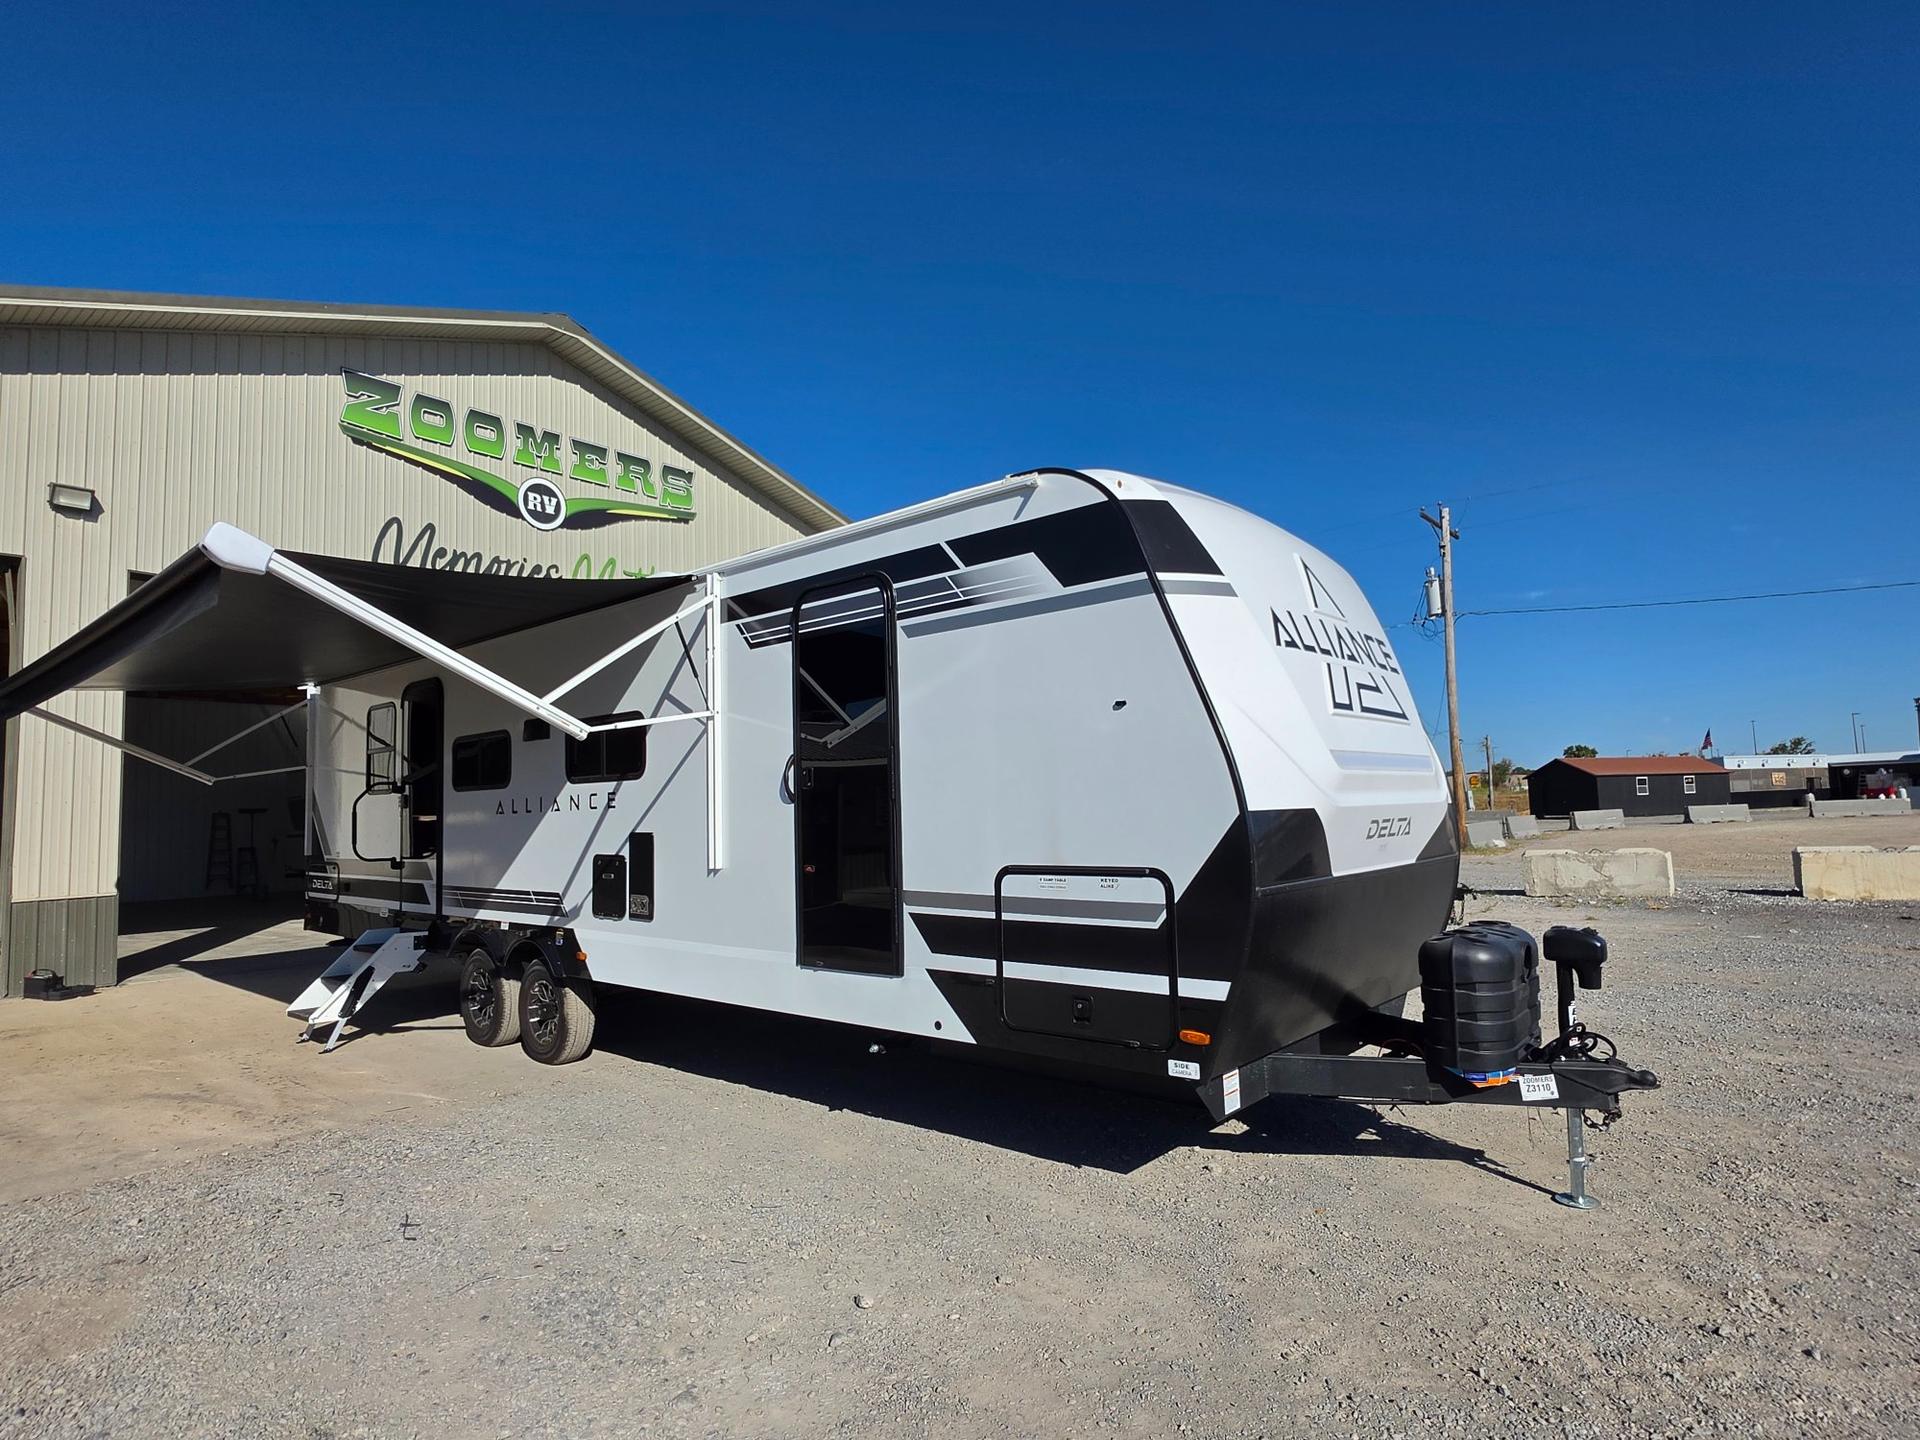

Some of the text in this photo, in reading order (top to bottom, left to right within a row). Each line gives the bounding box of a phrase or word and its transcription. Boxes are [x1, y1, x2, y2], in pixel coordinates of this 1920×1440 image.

[339, 366, 695, 510] ZOOMERS
[526, 490, 558, 516] RV
[1270, 606, 1400, 675] ALLIANCE
[495, 791, 617, 815] ALLIANCE
[1365, 816, 1412, 840] DELTA
[312, 879, 334, 890] DELTA
[1174, 1062, 1190, 1070] SIDE
[1522, 1075, 1553, 1085] ZOOMERS
[1525, 1083, 1551, 1093] Z3110
